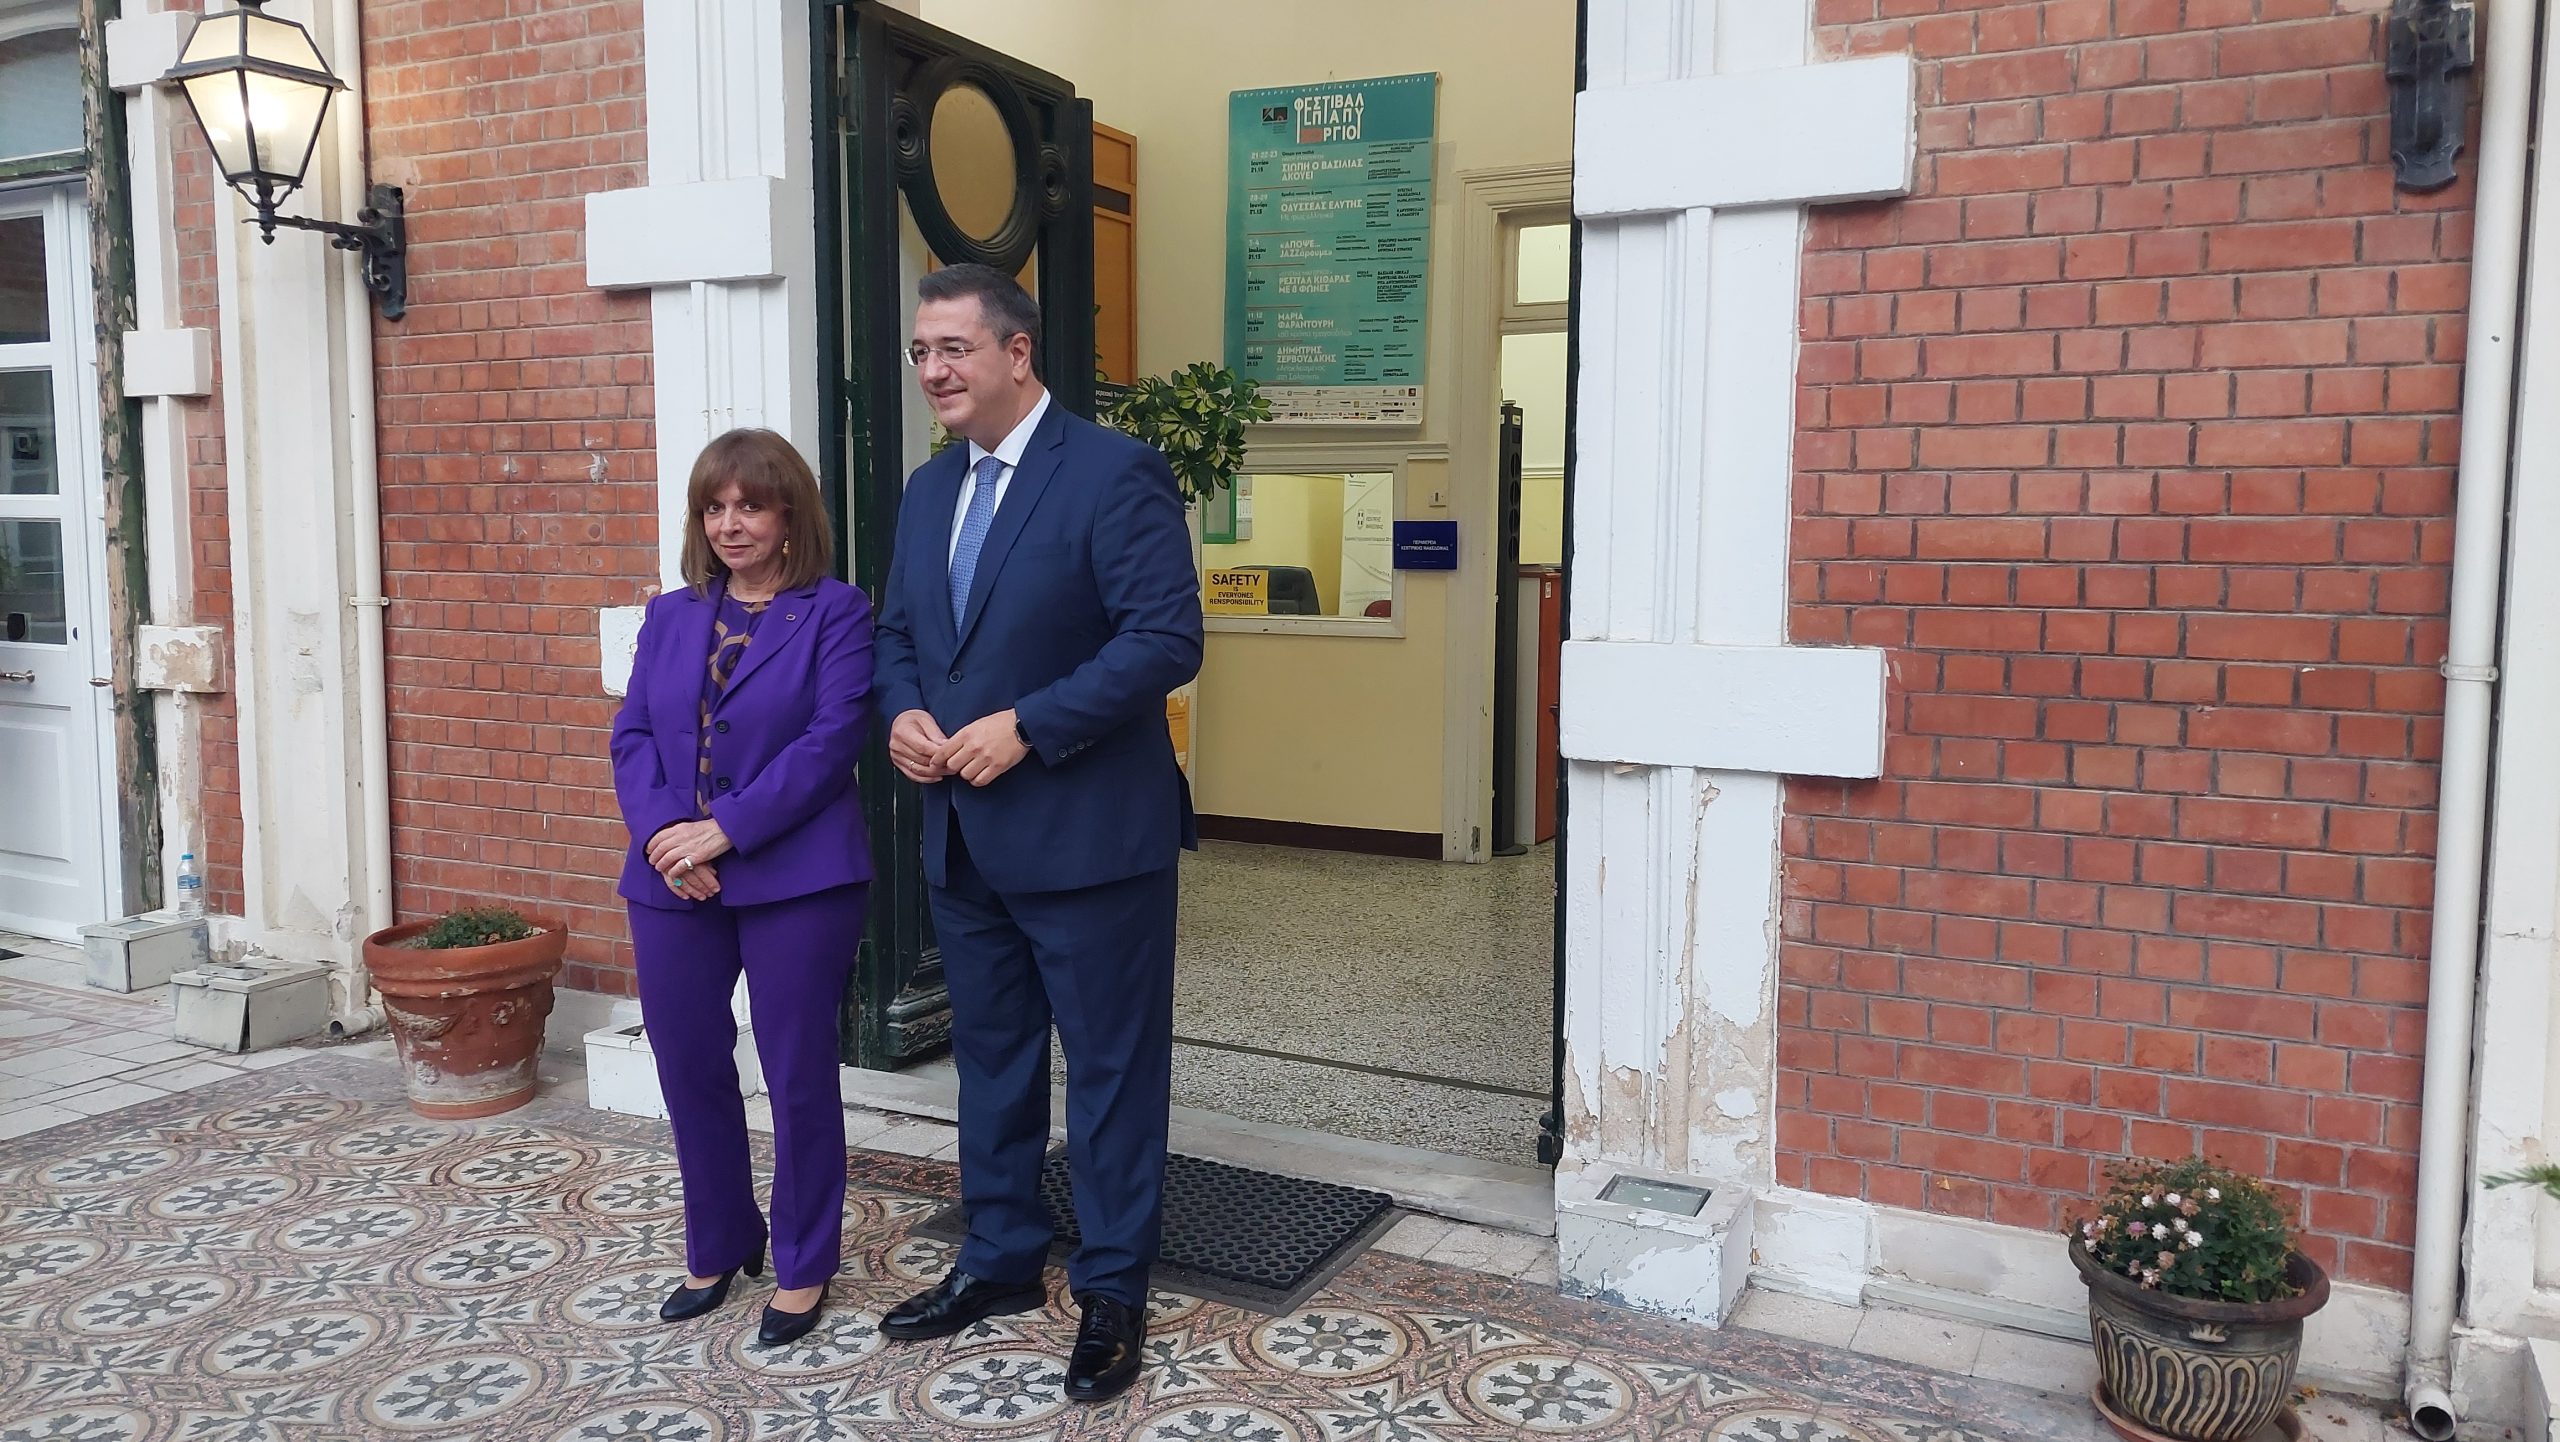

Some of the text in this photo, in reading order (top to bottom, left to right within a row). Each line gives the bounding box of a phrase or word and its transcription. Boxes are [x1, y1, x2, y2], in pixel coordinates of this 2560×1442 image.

[1312, 161, 1319, 170] Ο
[1321, 159, 1363, 170] ΒΑΣΙΛΙΑΣ
[1281, 171, 1314, 181] ΑΚΟΥΕΙ
[1281, 201, 1328, 212] ΟΔΥΣΣΕΑΣ
[1328, 199, 1363, 210] ΕΛΥΤΗΣ
[1313, 274, 1351, 284] ΚΙΘΑΡΑΣ
[1279, 285, 1291, 294] ΜΕ
[1298, 284, 1330, 293] ΦΩΝΕΣ
[1278, 311, 1304, 320] ΜΑΡΙΑ
[1277, 320, 1334, 329] ΦΑΡΑΝΤΟΥΡΗ
[1277, 345, 1322, 355] ΔΗΜΗΤΡΗΣ
[1277, 354, 1337, 363] ΖΕΡΒΟΥΔΑΚΗΣ
[1212, 573, 1261, 586] SAFETY
